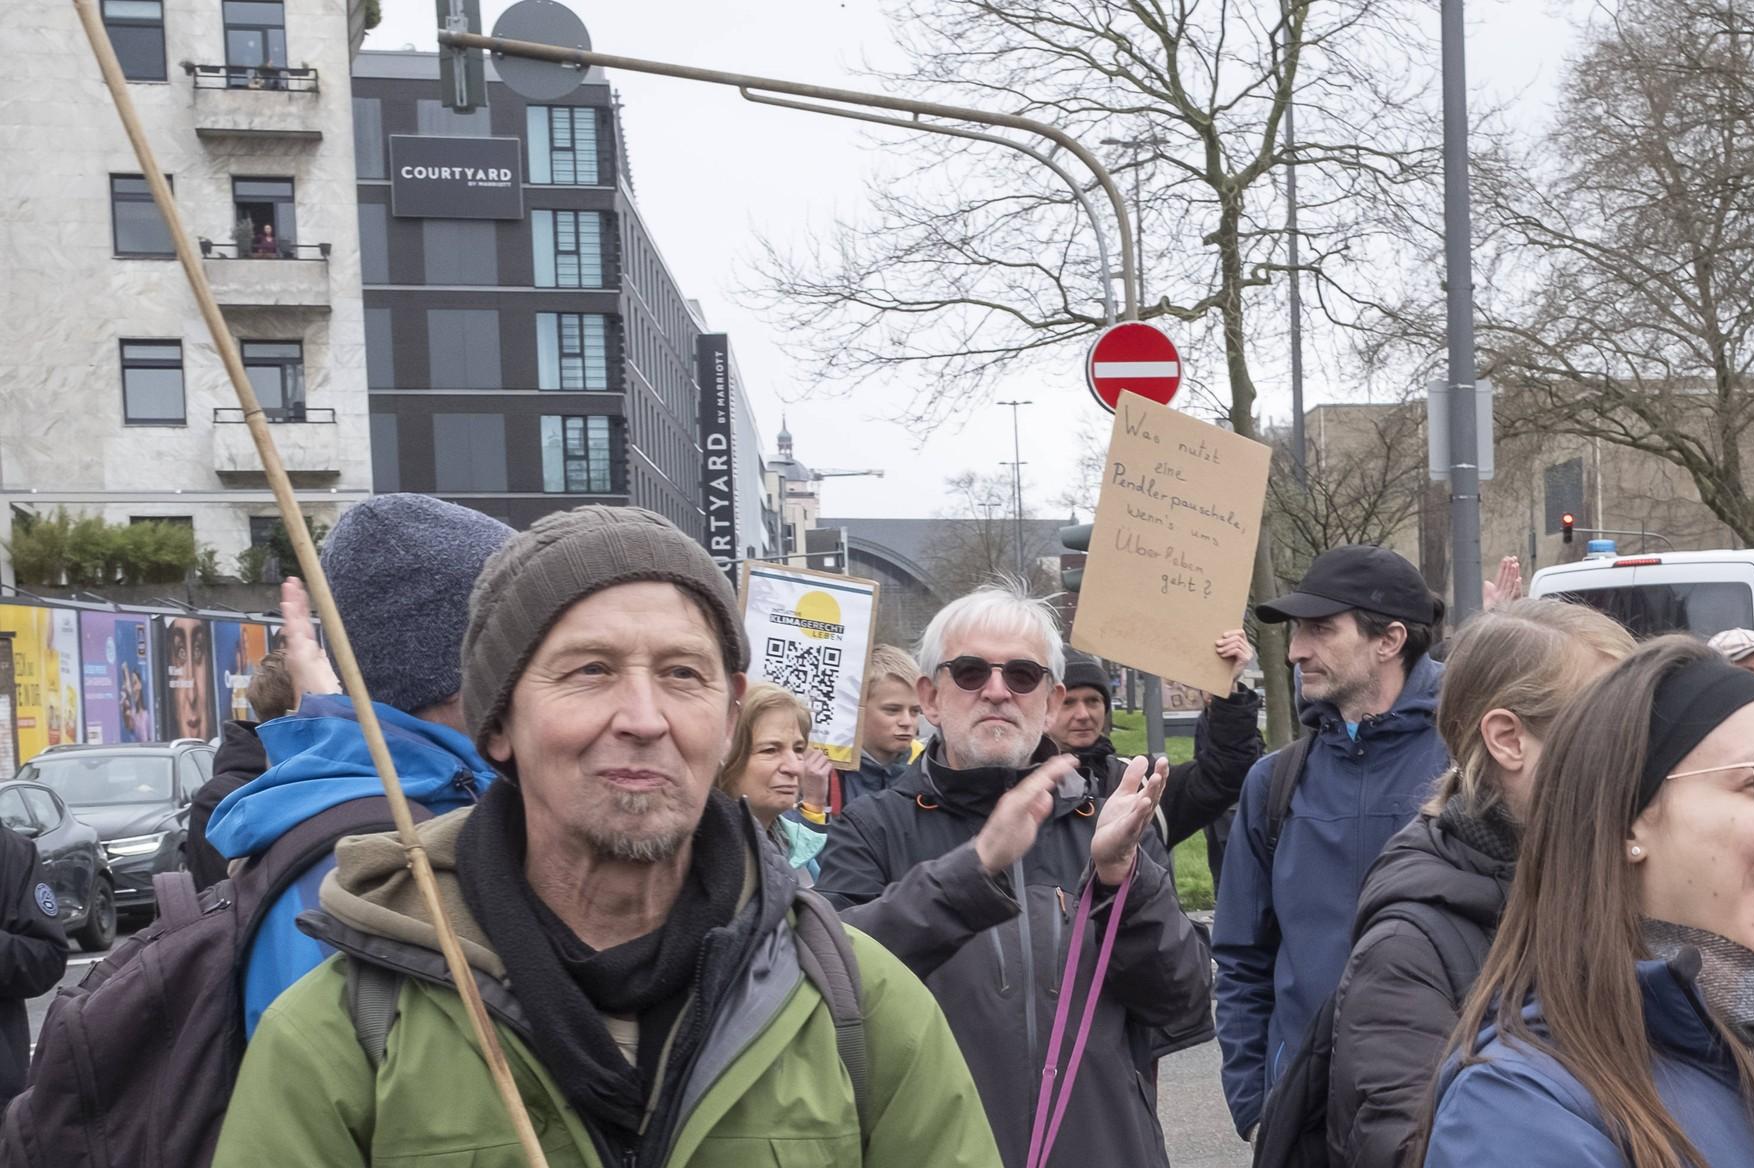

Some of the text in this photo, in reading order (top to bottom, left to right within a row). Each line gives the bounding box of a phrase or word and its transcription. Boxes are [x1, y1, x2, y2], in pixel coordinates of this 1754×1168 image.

[400, 166, 512, 181] COURTYARD
[1124, 404, 1221, 465] Was nutzt
[707, 351, 732, 573] URTYARD BY MARRIOTT
[1154, 462, 1187, 482] eine
[1112, 462, 1246, 535] Pendlerpauschale,
[1190, 528, 1220, 547] ums
[1114, 525, 1205, 575] Überleben
[1160, 573, 1197, 594] geht
[770, 614, 844, 635] KLIMAGERECHT
[812, 630, 843, 641] LEBEN
